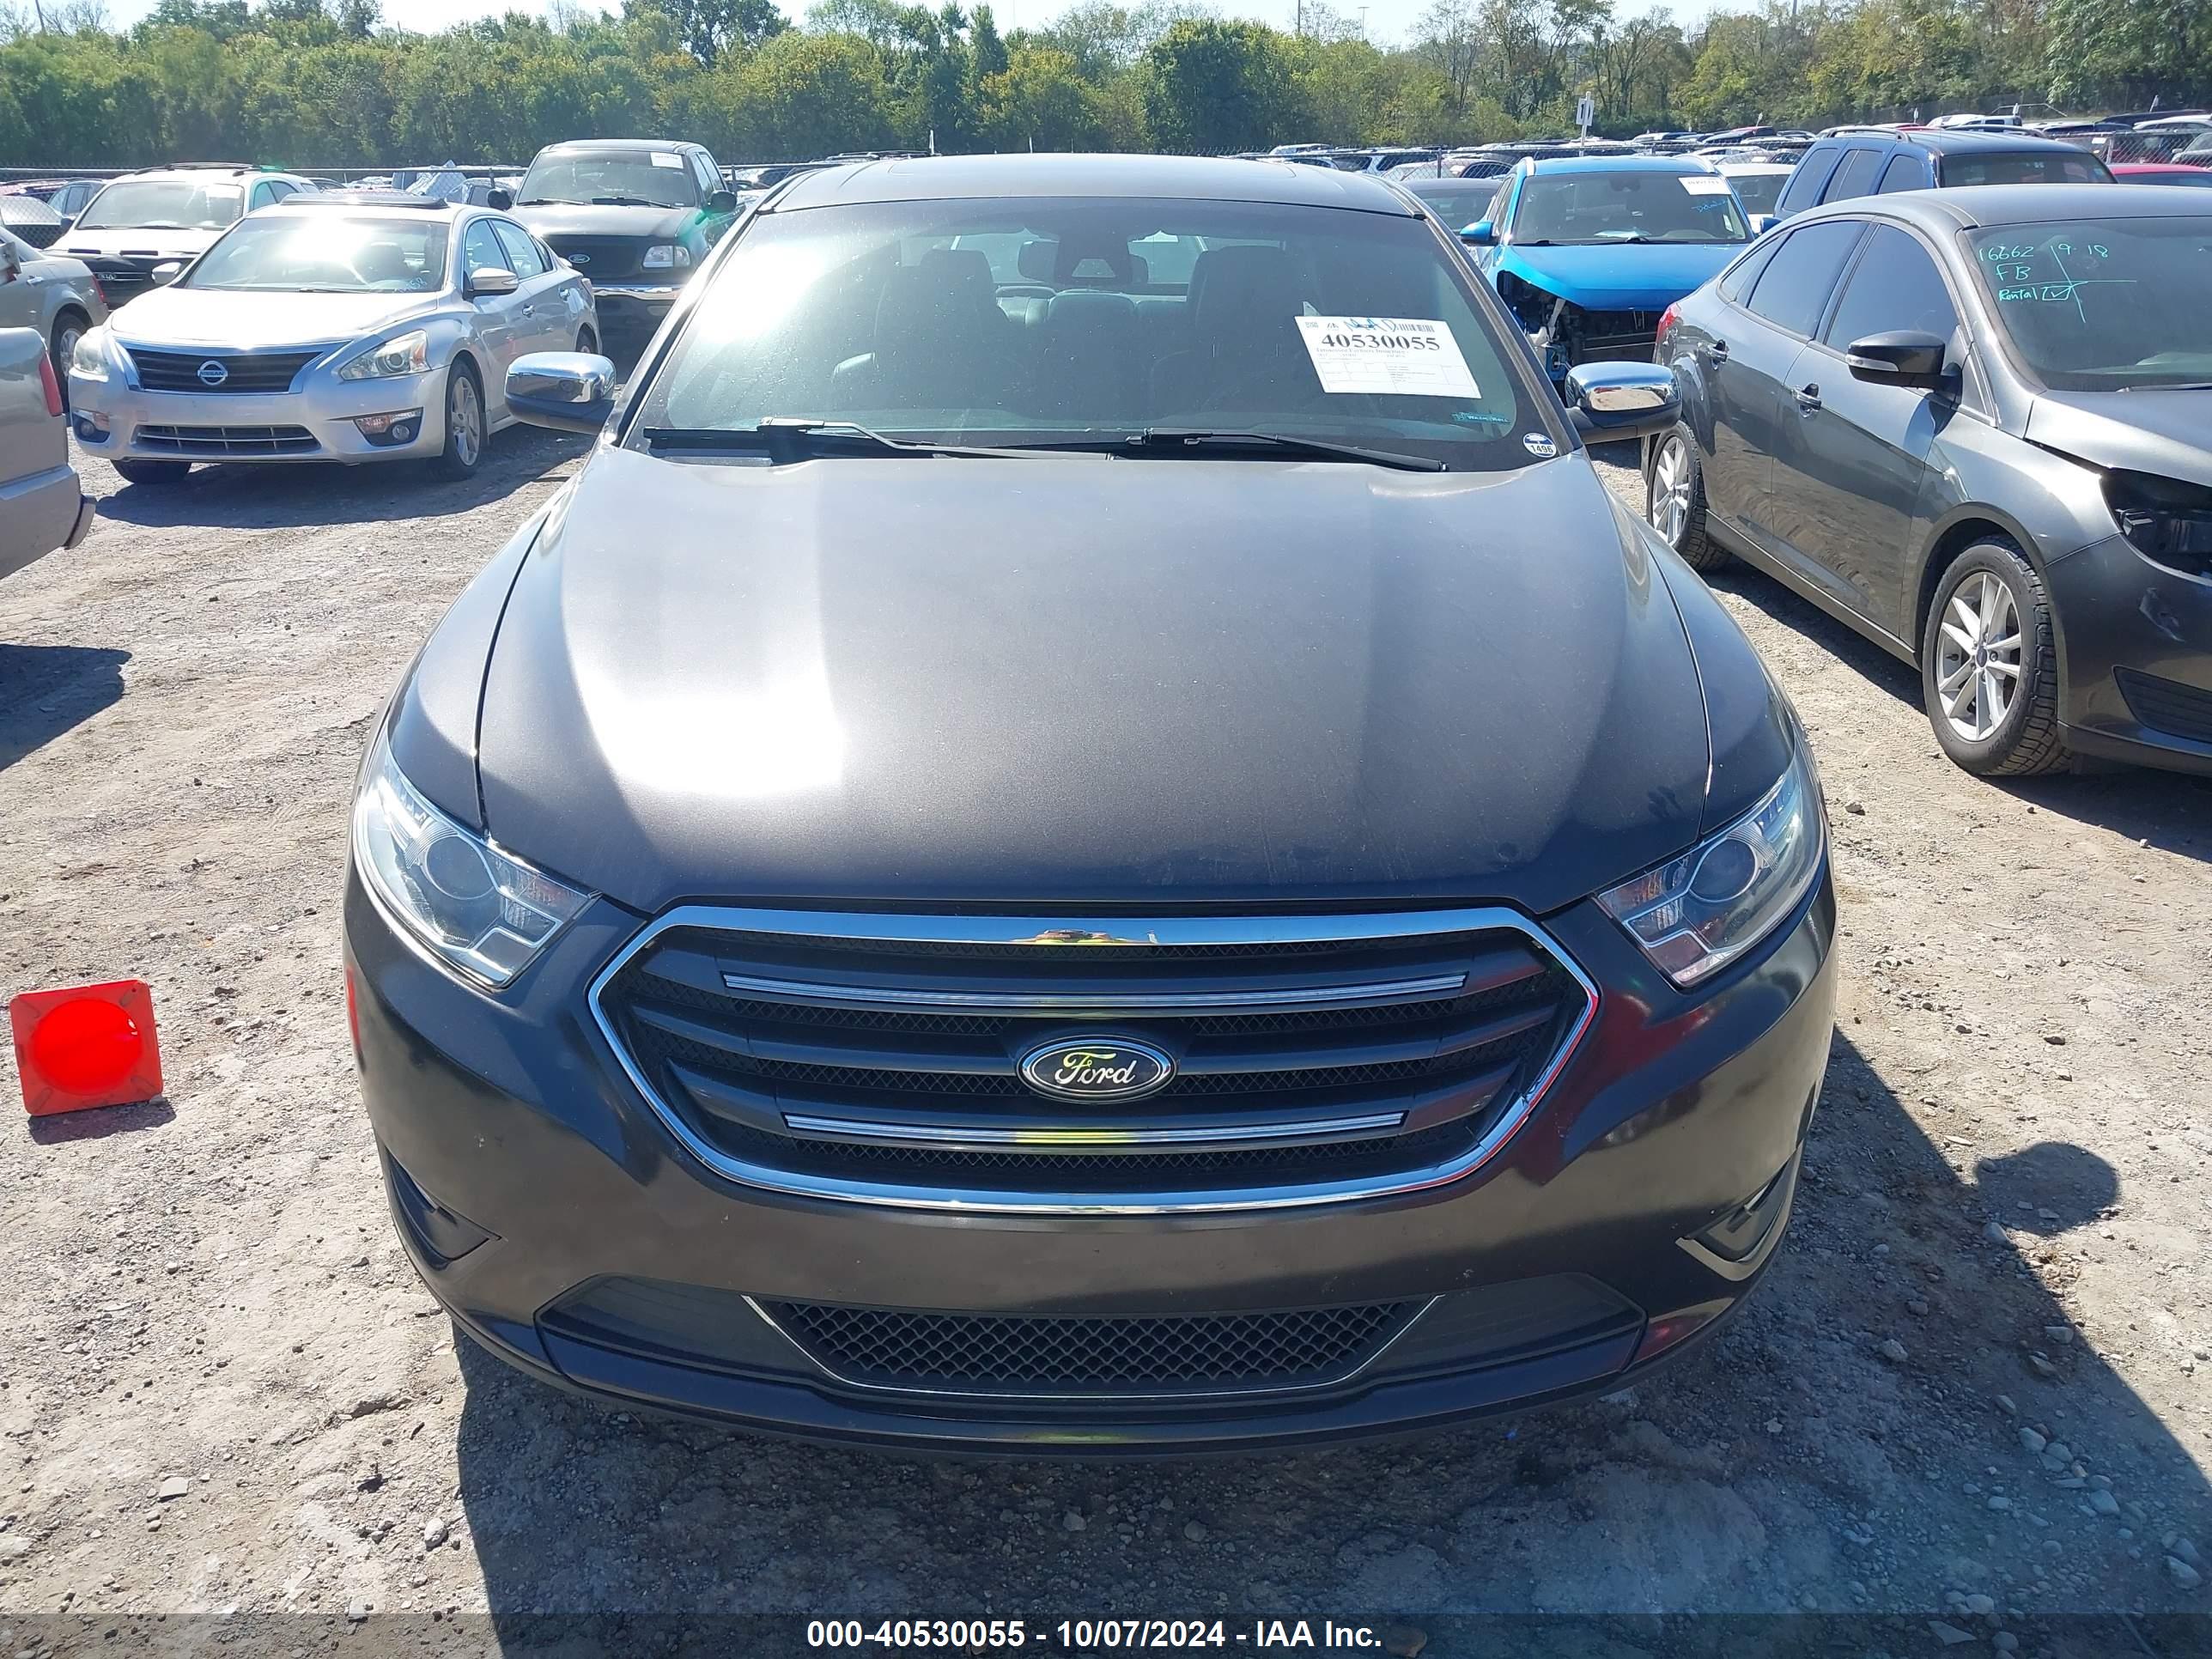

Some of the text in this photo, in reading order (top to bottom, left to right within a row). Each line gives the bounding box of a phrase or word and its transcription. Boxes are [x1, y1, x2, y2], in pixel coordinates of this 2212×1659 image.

[1322, 333, 1441, 350] 40530055
[1530, 445, 1554, 453] 1496
[1054, 1051, 1137, 1085] Ford
